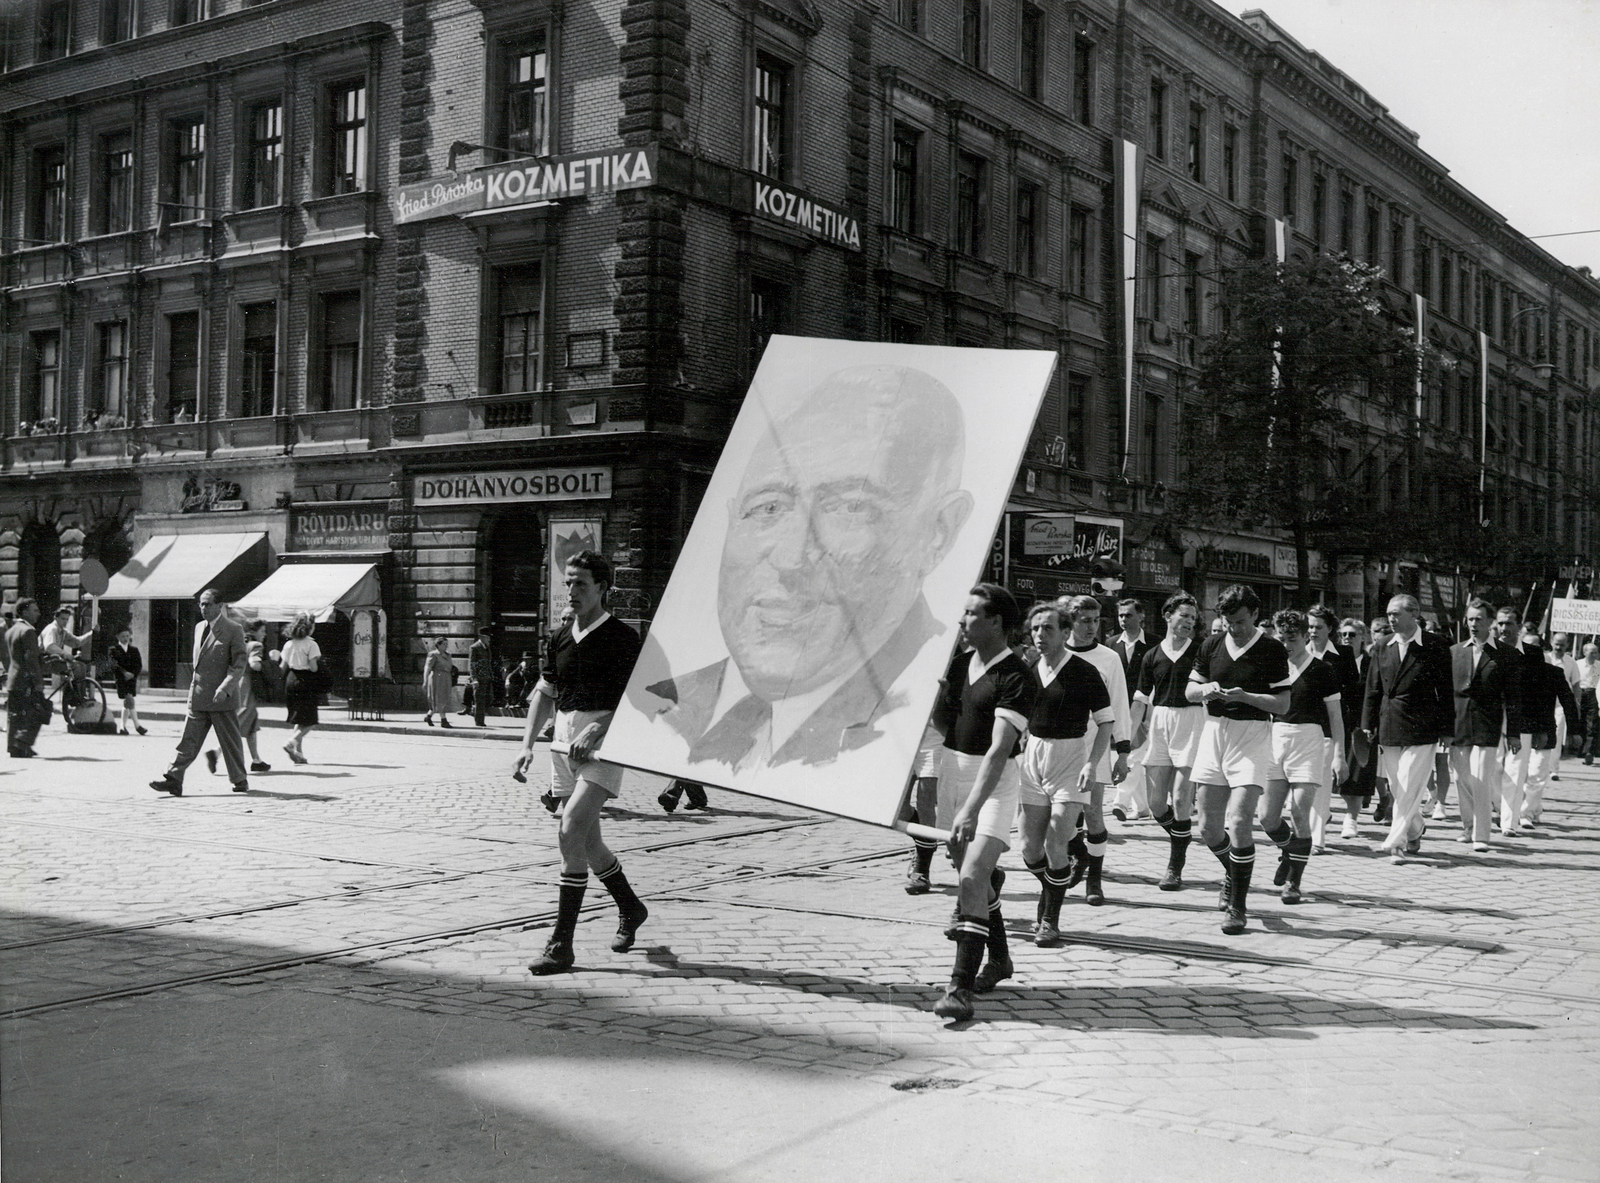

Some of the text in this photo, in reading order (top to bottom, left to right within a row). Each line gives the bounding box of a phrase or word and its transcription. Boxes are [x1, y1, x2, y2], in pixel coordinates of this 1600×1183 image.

[431, 172, 486, 204] Piroska
[486, 151, 653, 203] KOZMETIKA
[755, 180, 862, 249] KOZMETIKA
[421, 471, 605, 500] DOHÁNYOSBOLT
[297, 511, 386, 534] RÖVIDÁRU
[1017, 578, 1035, 590] FOTO
[1058, 581, 1090, 595] SZEMÜVEG
